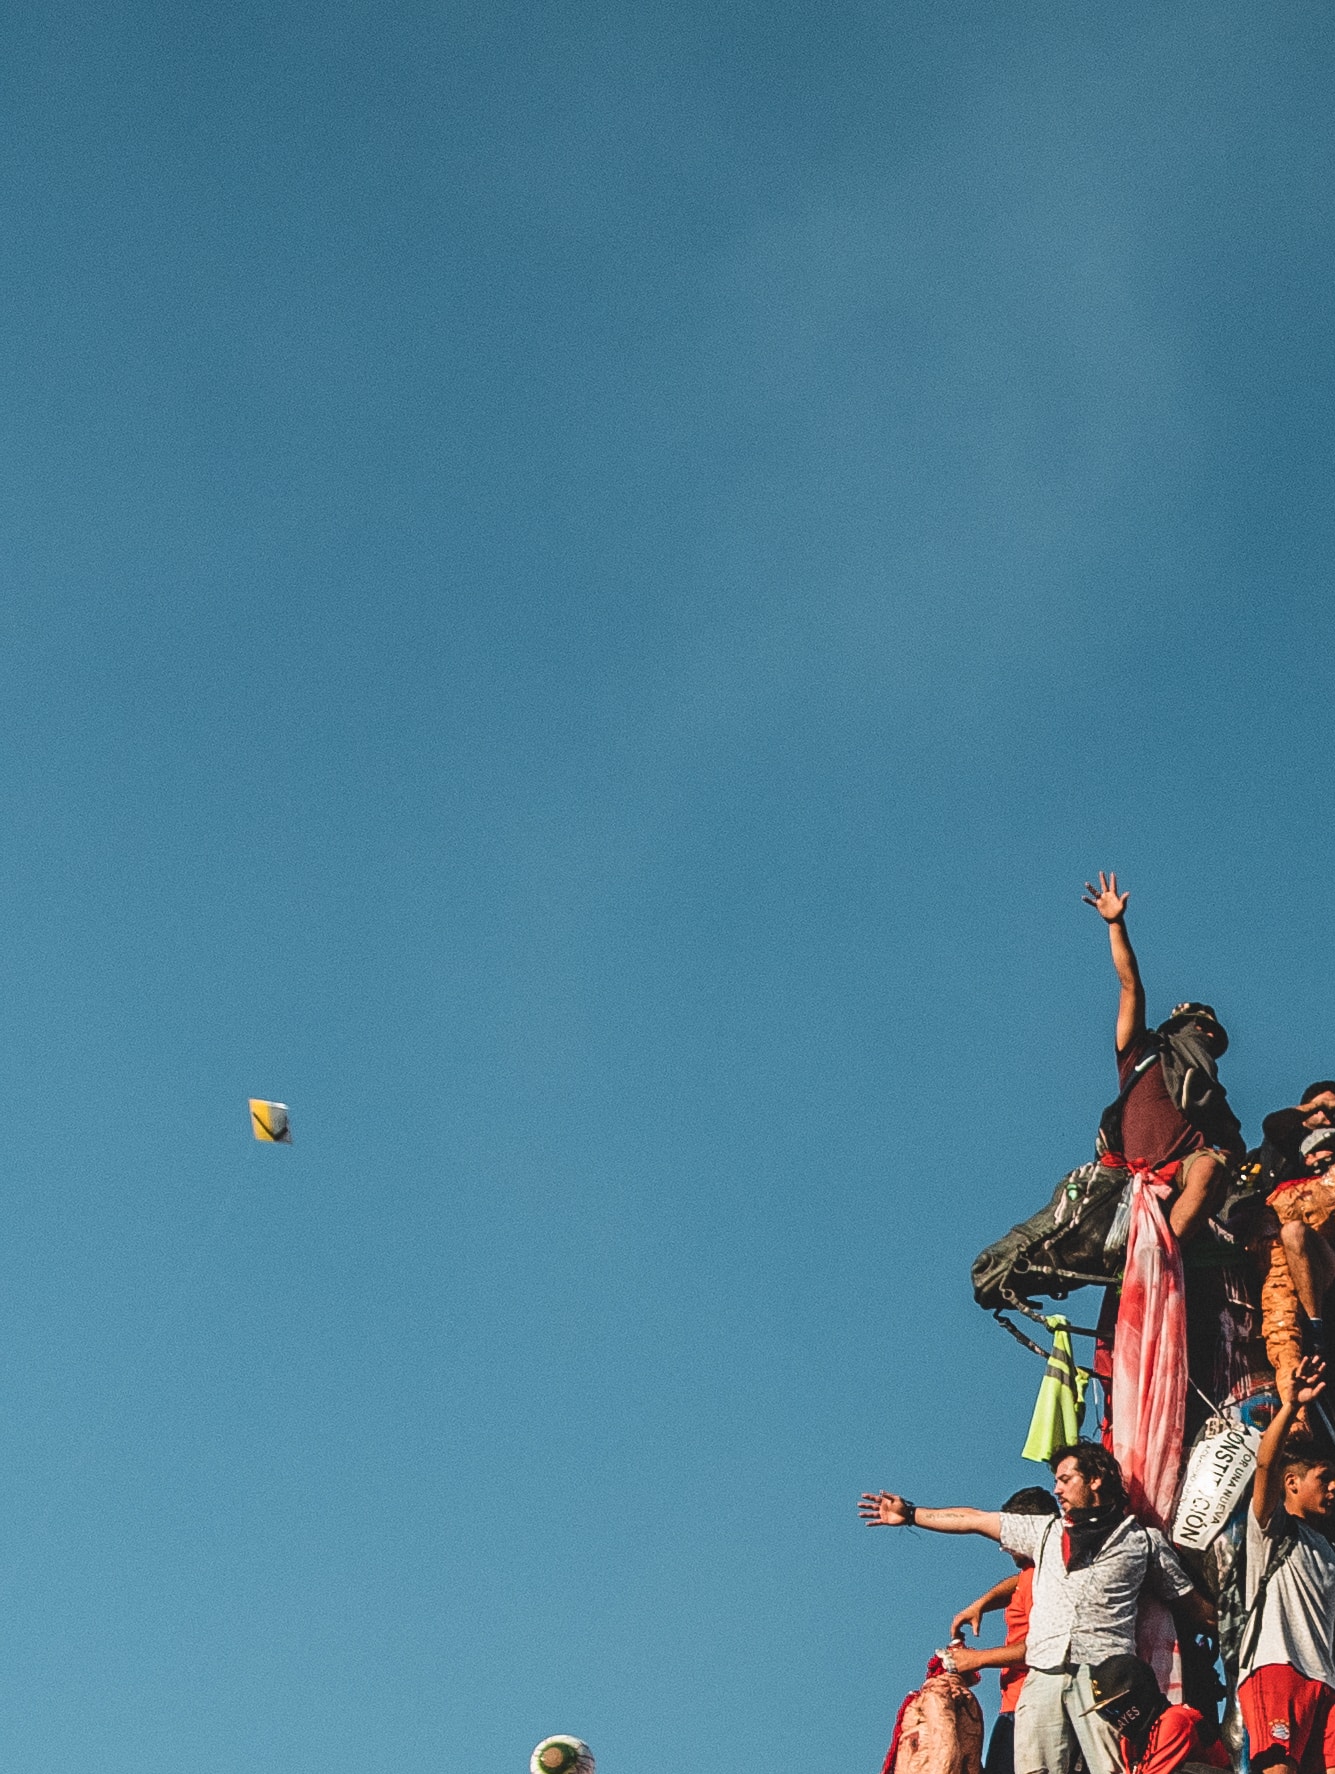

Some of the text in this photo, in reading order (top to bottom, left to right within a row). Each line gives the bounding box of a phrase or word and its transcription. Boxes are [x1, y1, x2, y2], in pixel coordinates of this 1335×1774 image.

[1180, 1431, 1245, 1543] ONSTITCIÓN
[1211, 1453, 1252, 1524] OR UNA NUEVA
